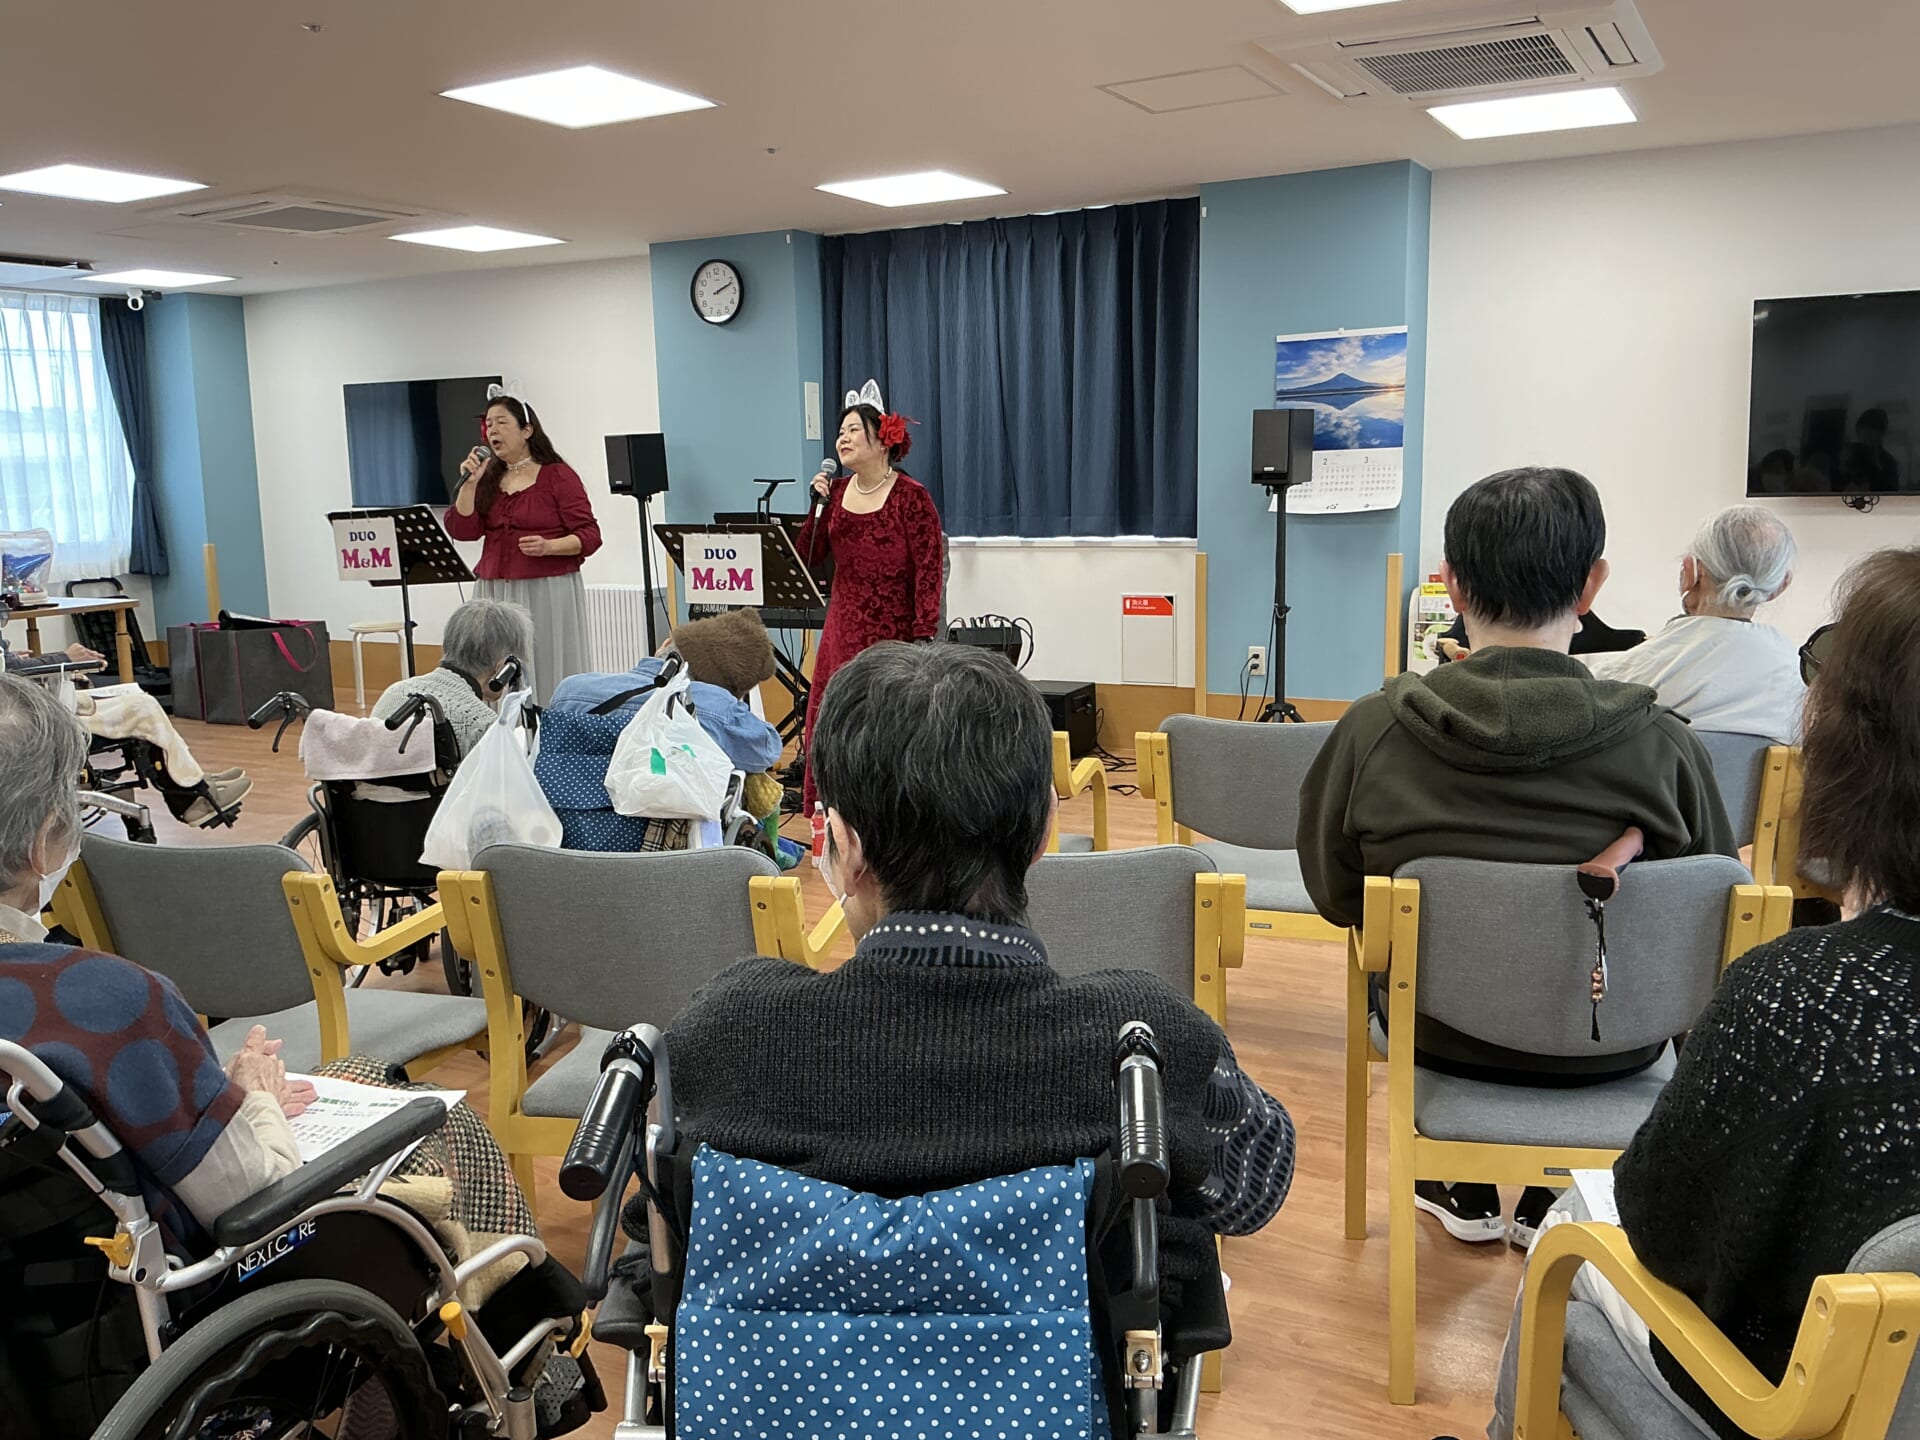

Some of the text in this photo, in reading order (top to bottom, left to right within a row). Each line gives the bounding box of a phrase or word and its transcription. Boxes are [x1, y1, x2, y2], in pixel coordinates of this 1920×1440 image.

[349, 530, 377, 542] DUO
[341, 547, 393, 569] M&M
[703, 548, 737, 560] DUO
[691, 567, 754, 592] M&M
